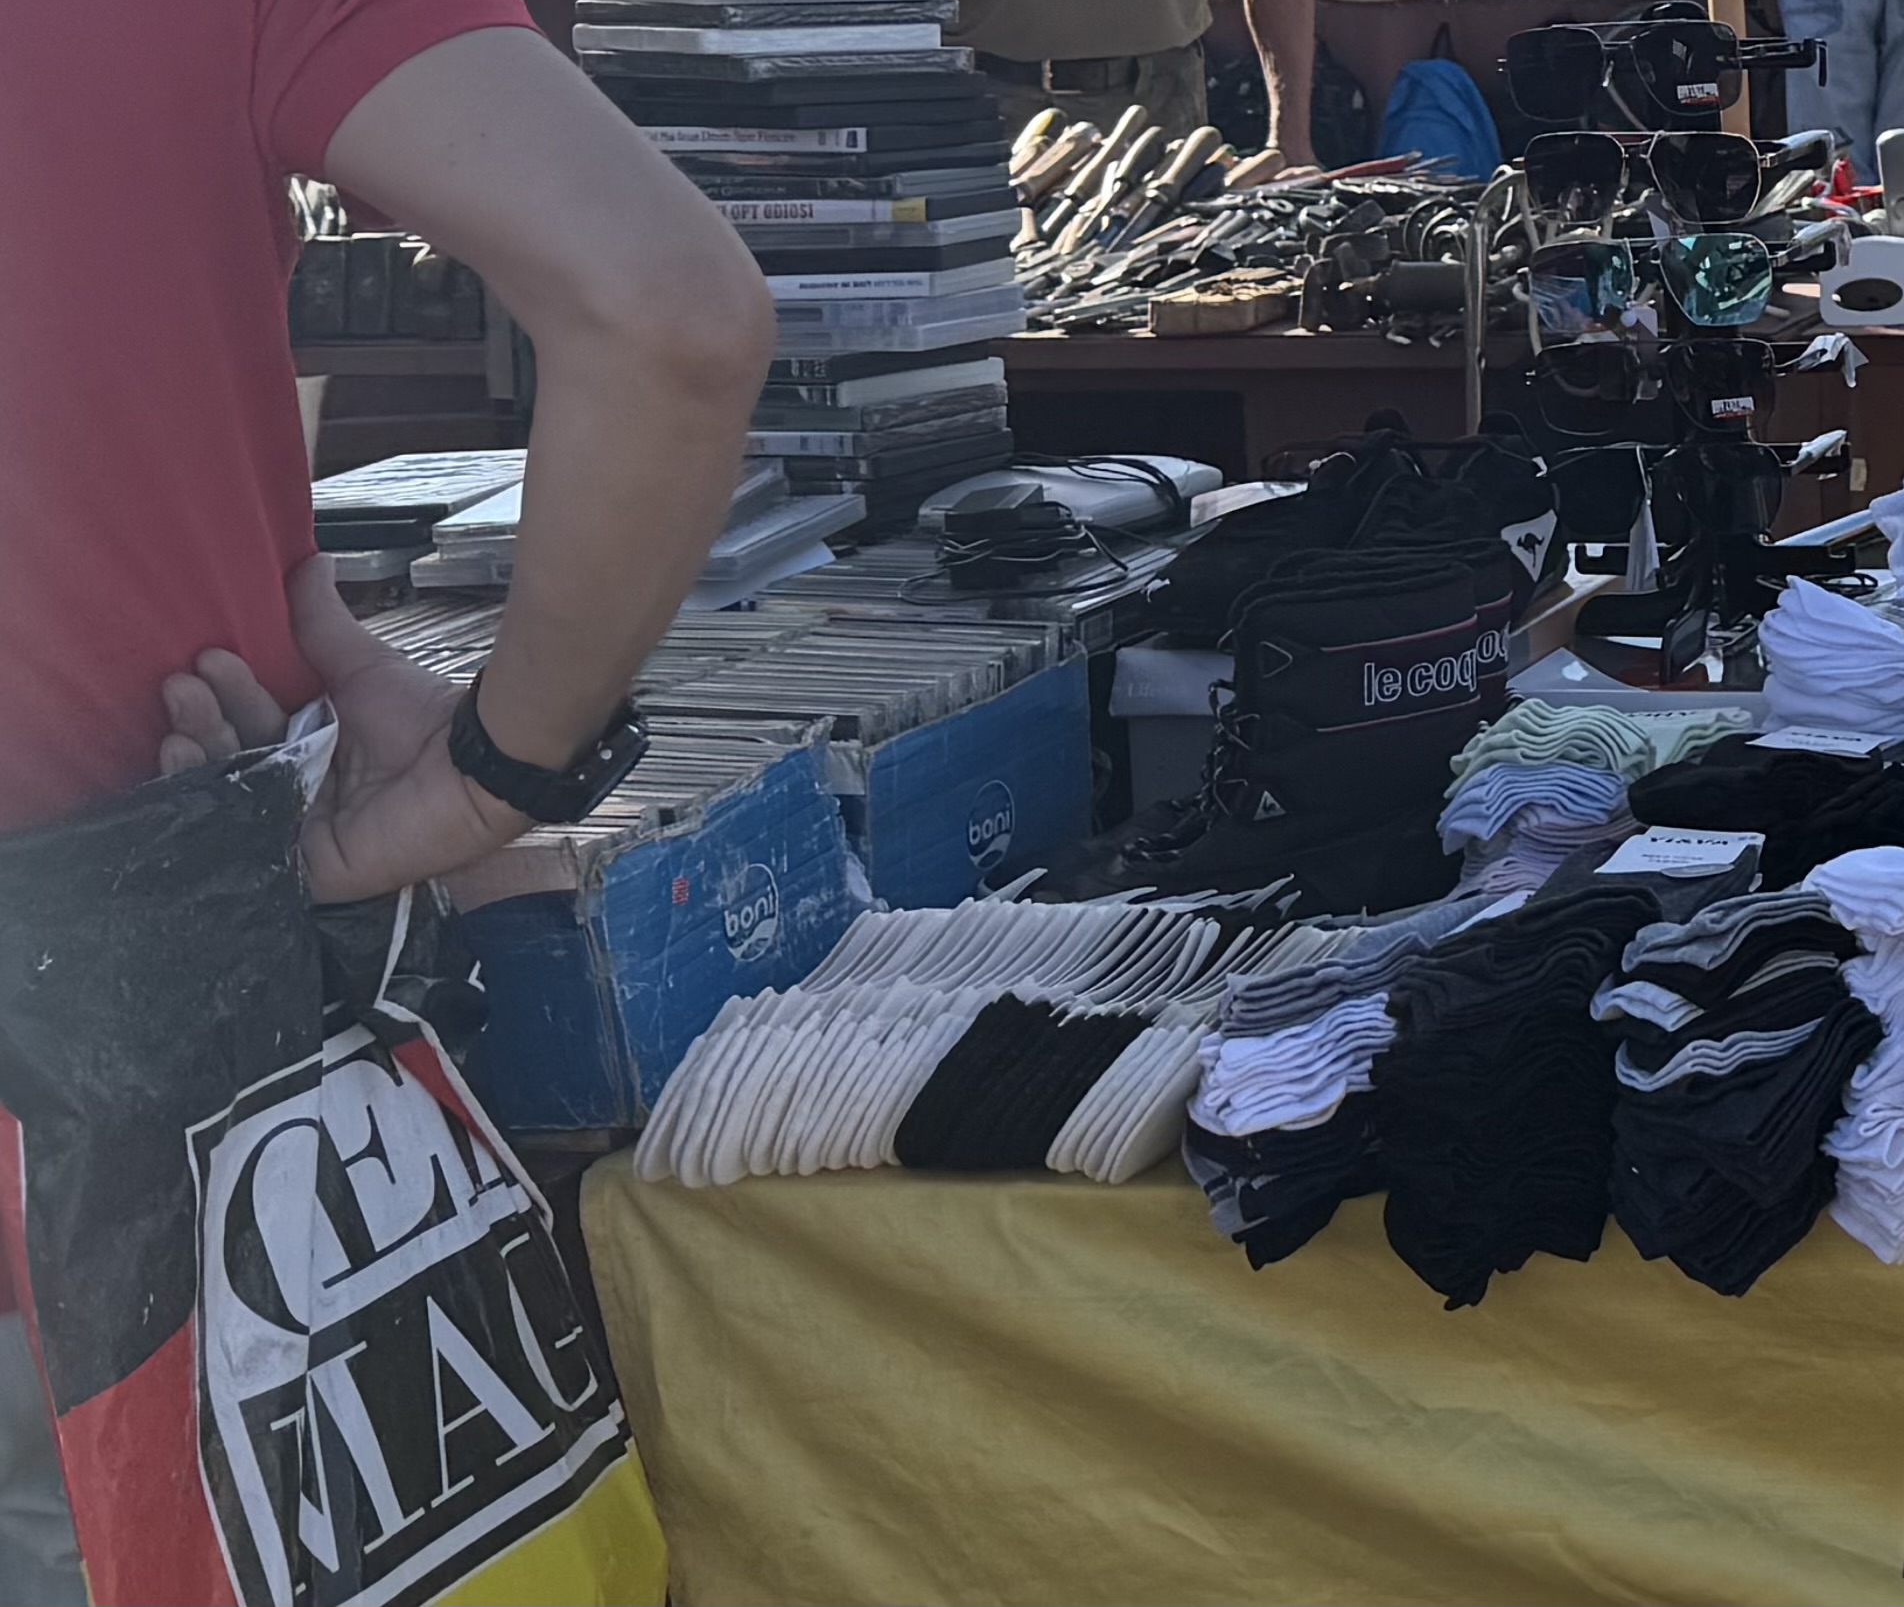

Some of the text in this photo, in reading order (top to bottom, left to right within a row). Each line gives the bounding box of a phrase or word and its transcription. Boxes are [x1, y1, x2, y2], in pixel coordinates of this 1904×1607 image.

[1363, 648, 1478, 706] le coq
[969, 804, 1011, 846] boni
[723, 885, 777, 938] boni
